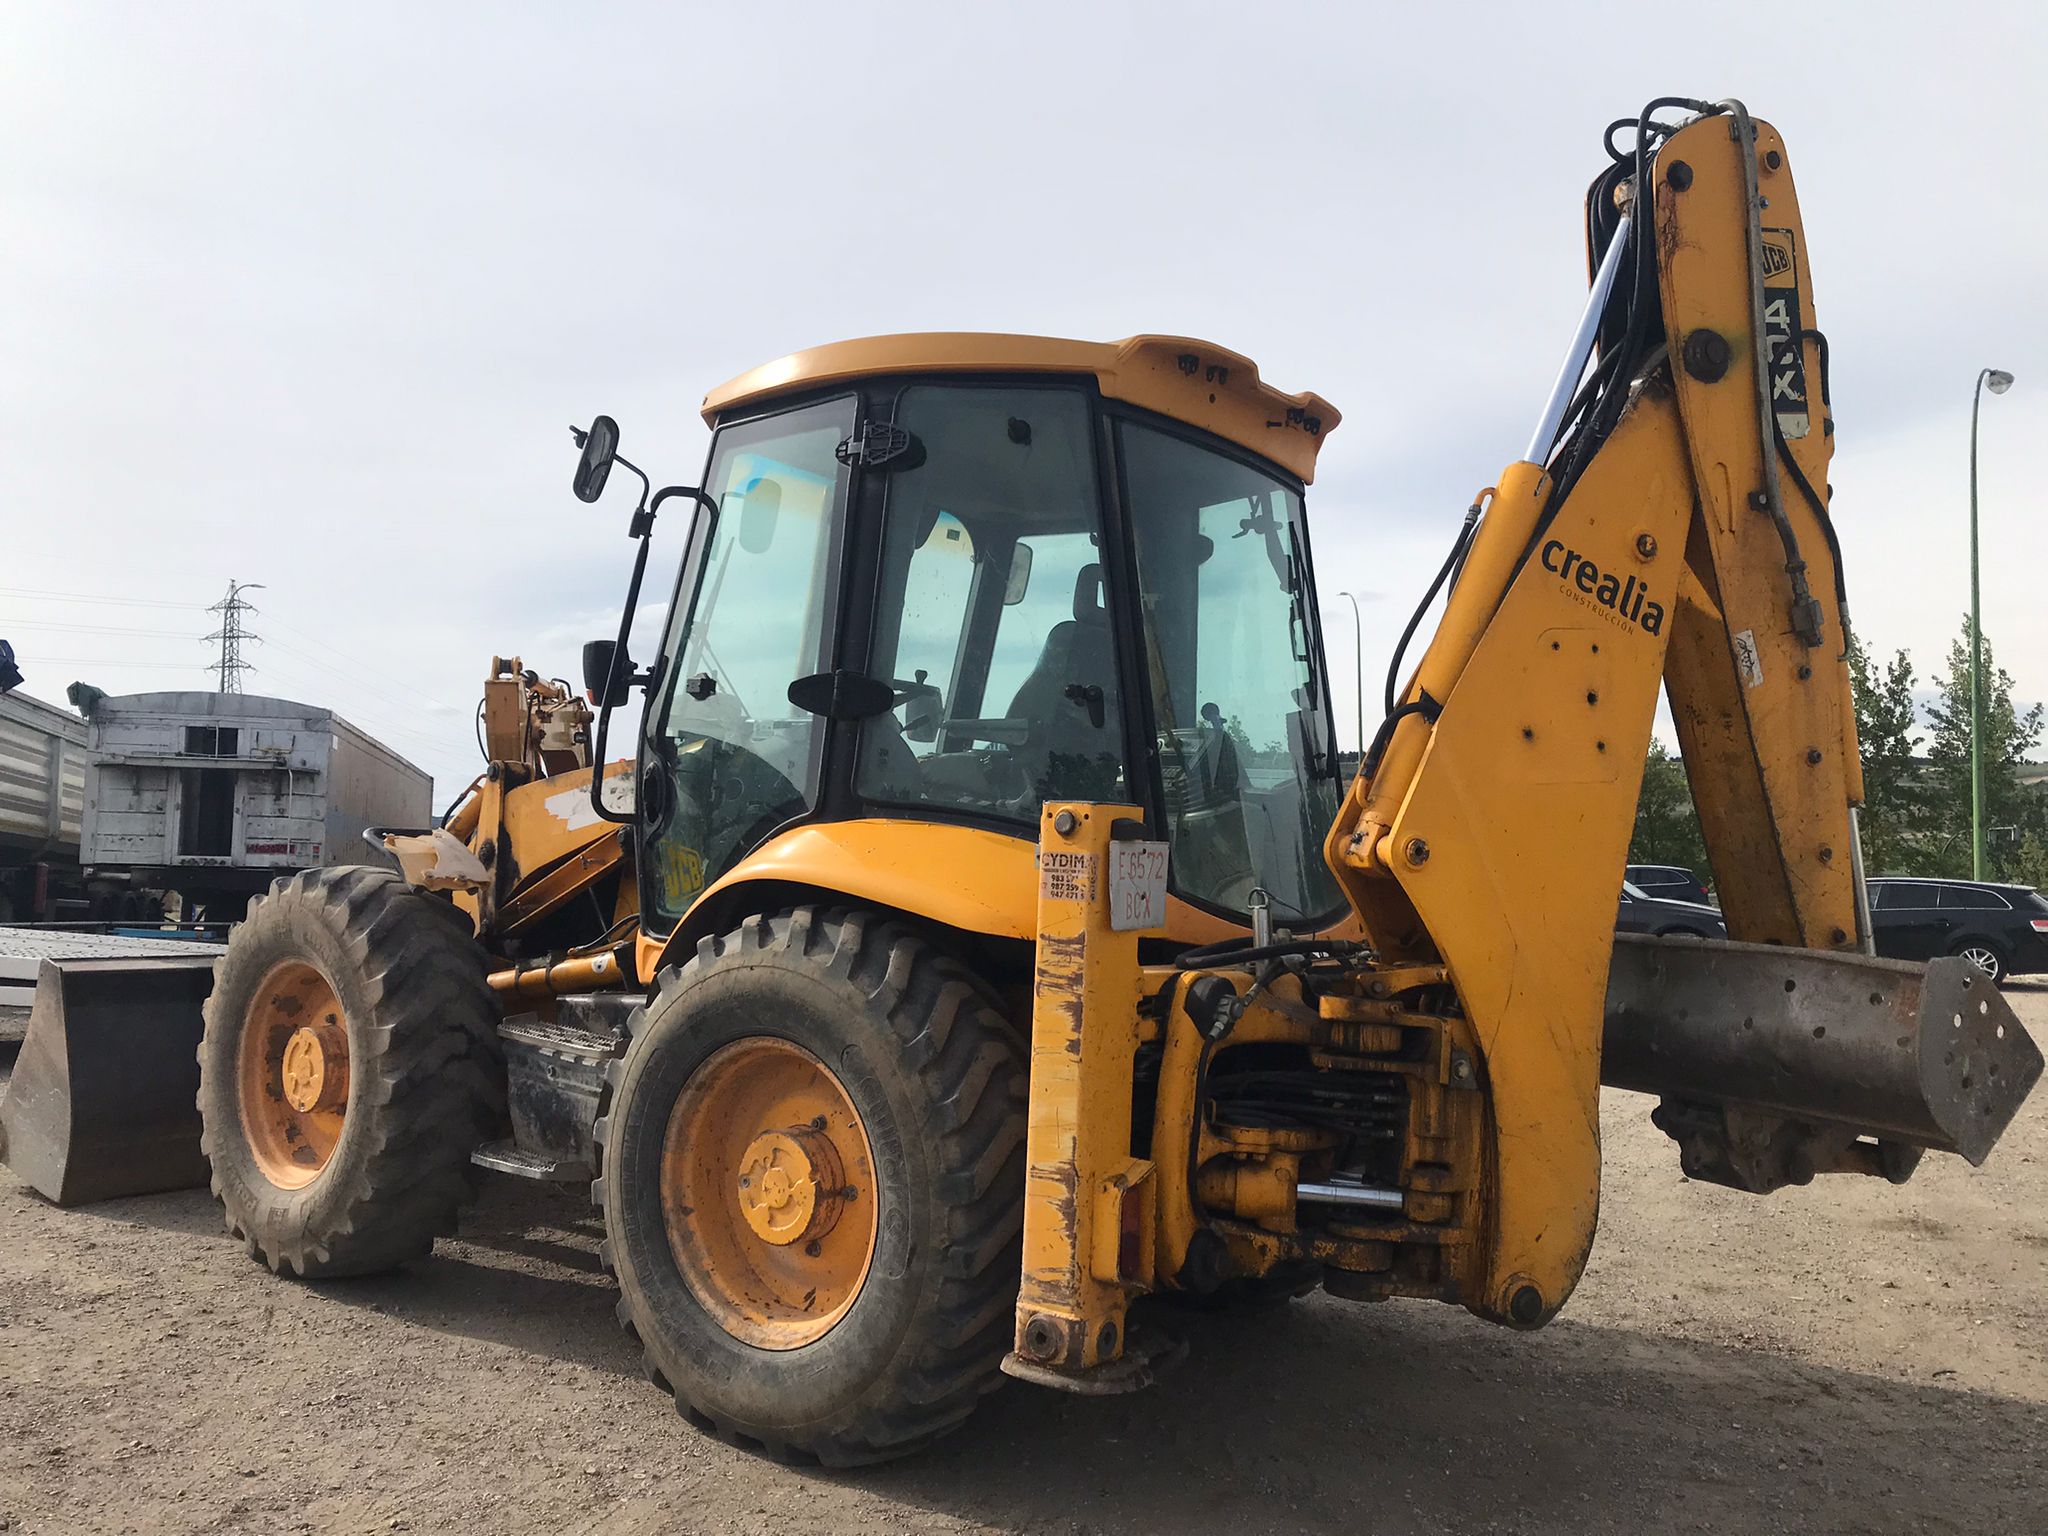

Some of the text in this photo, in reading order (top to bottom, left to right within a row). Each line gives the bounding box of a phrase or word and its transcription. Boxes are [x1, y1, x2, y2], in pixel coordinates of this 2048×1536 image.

[1761, 244, 1788, 274] JCB
[1541, 539, 1665, 637] crealia
[1042, 853, 1090, 868] CYDIM
